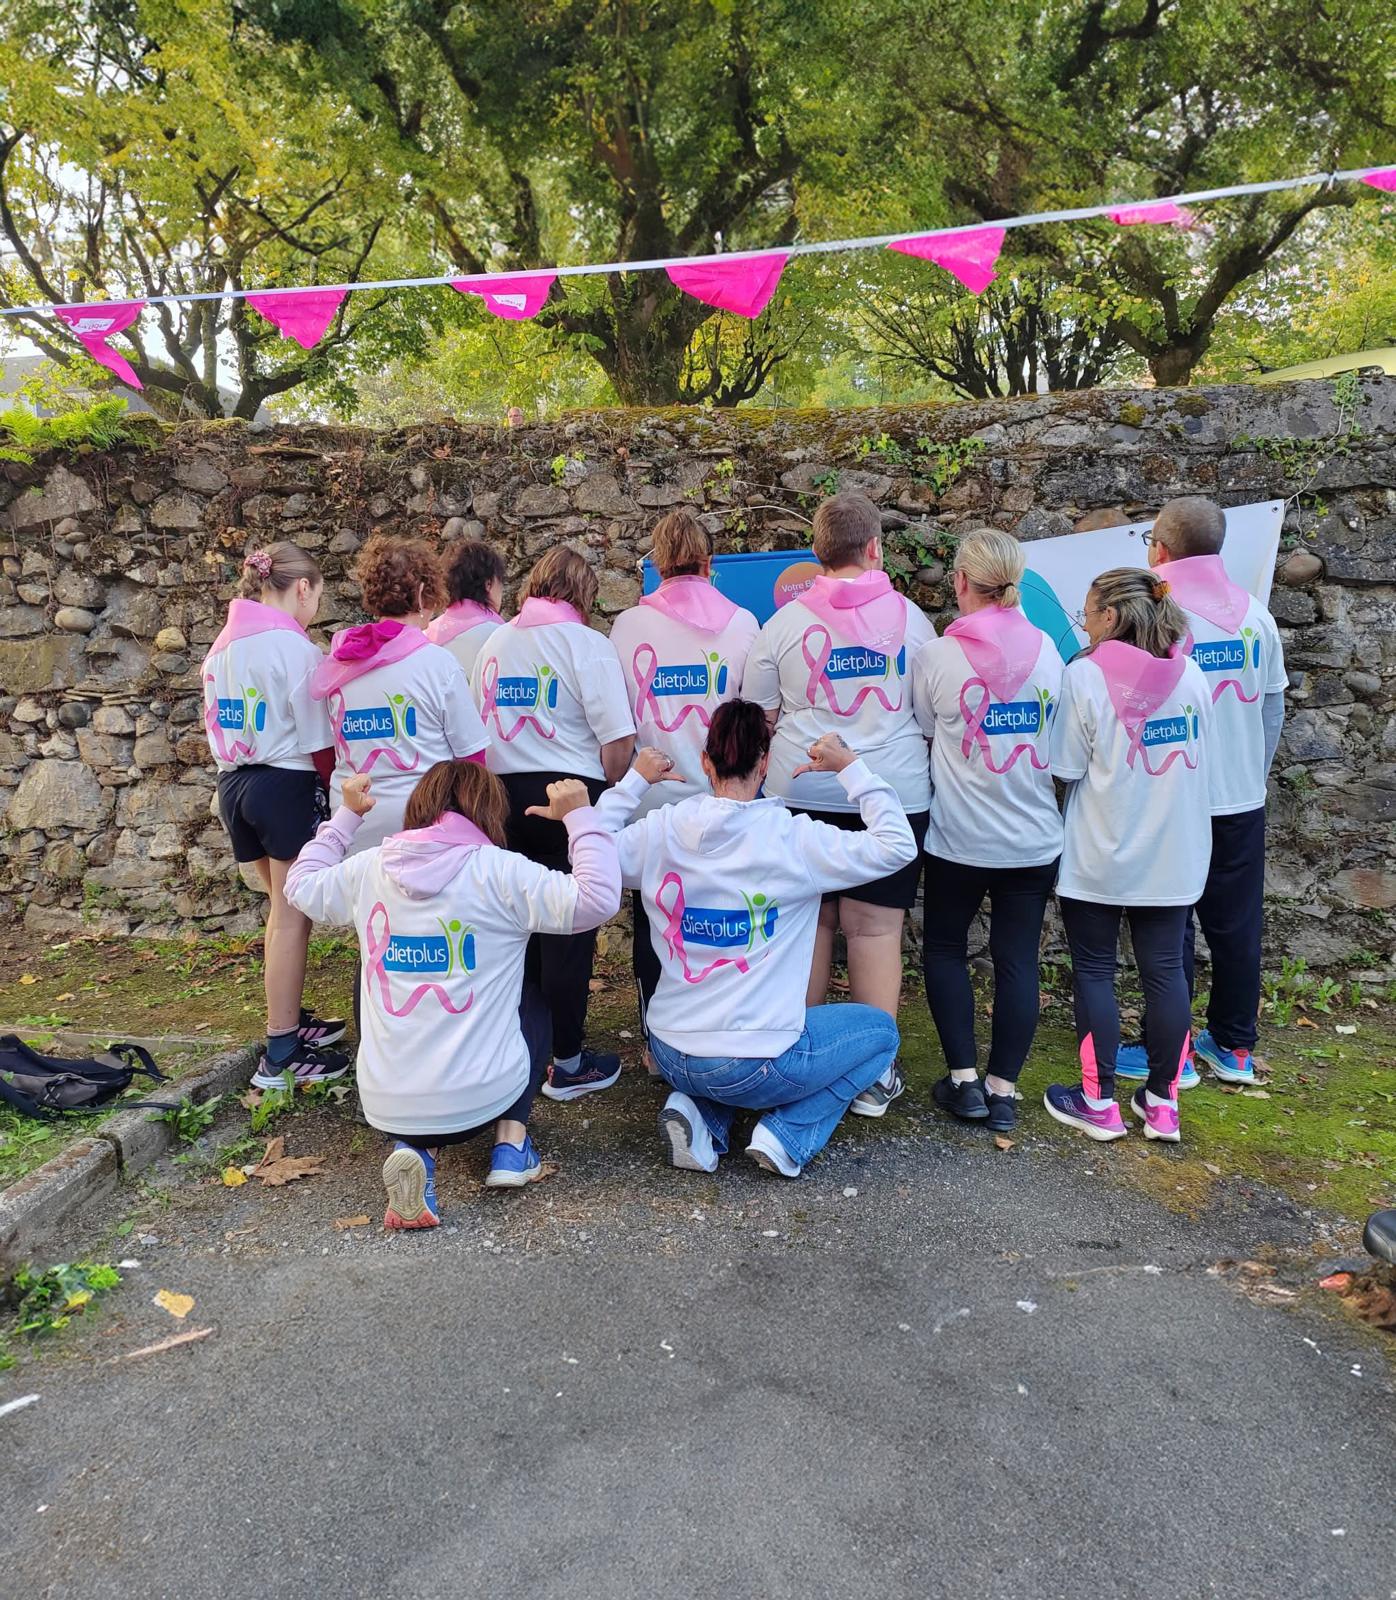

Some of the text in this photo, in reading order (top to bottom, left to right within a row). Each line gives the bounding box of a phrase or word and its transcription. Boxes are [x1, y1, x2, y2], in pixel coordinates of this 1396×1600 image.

[781, 583, 804, 593] Votre
[827, 650, 885, 674] dietplus
[1191, 645, 1244, 667] dietplus
[653, 670, 707, 689] dietplus
[342, 711, 393, 735] dietplus
[984, 705, 1038, 729] dietplus
[1142, 722, 1187, 741] dietplus
[682, 915, 748, 939] dietplus
[386, 945, 447, 965] dietplus
